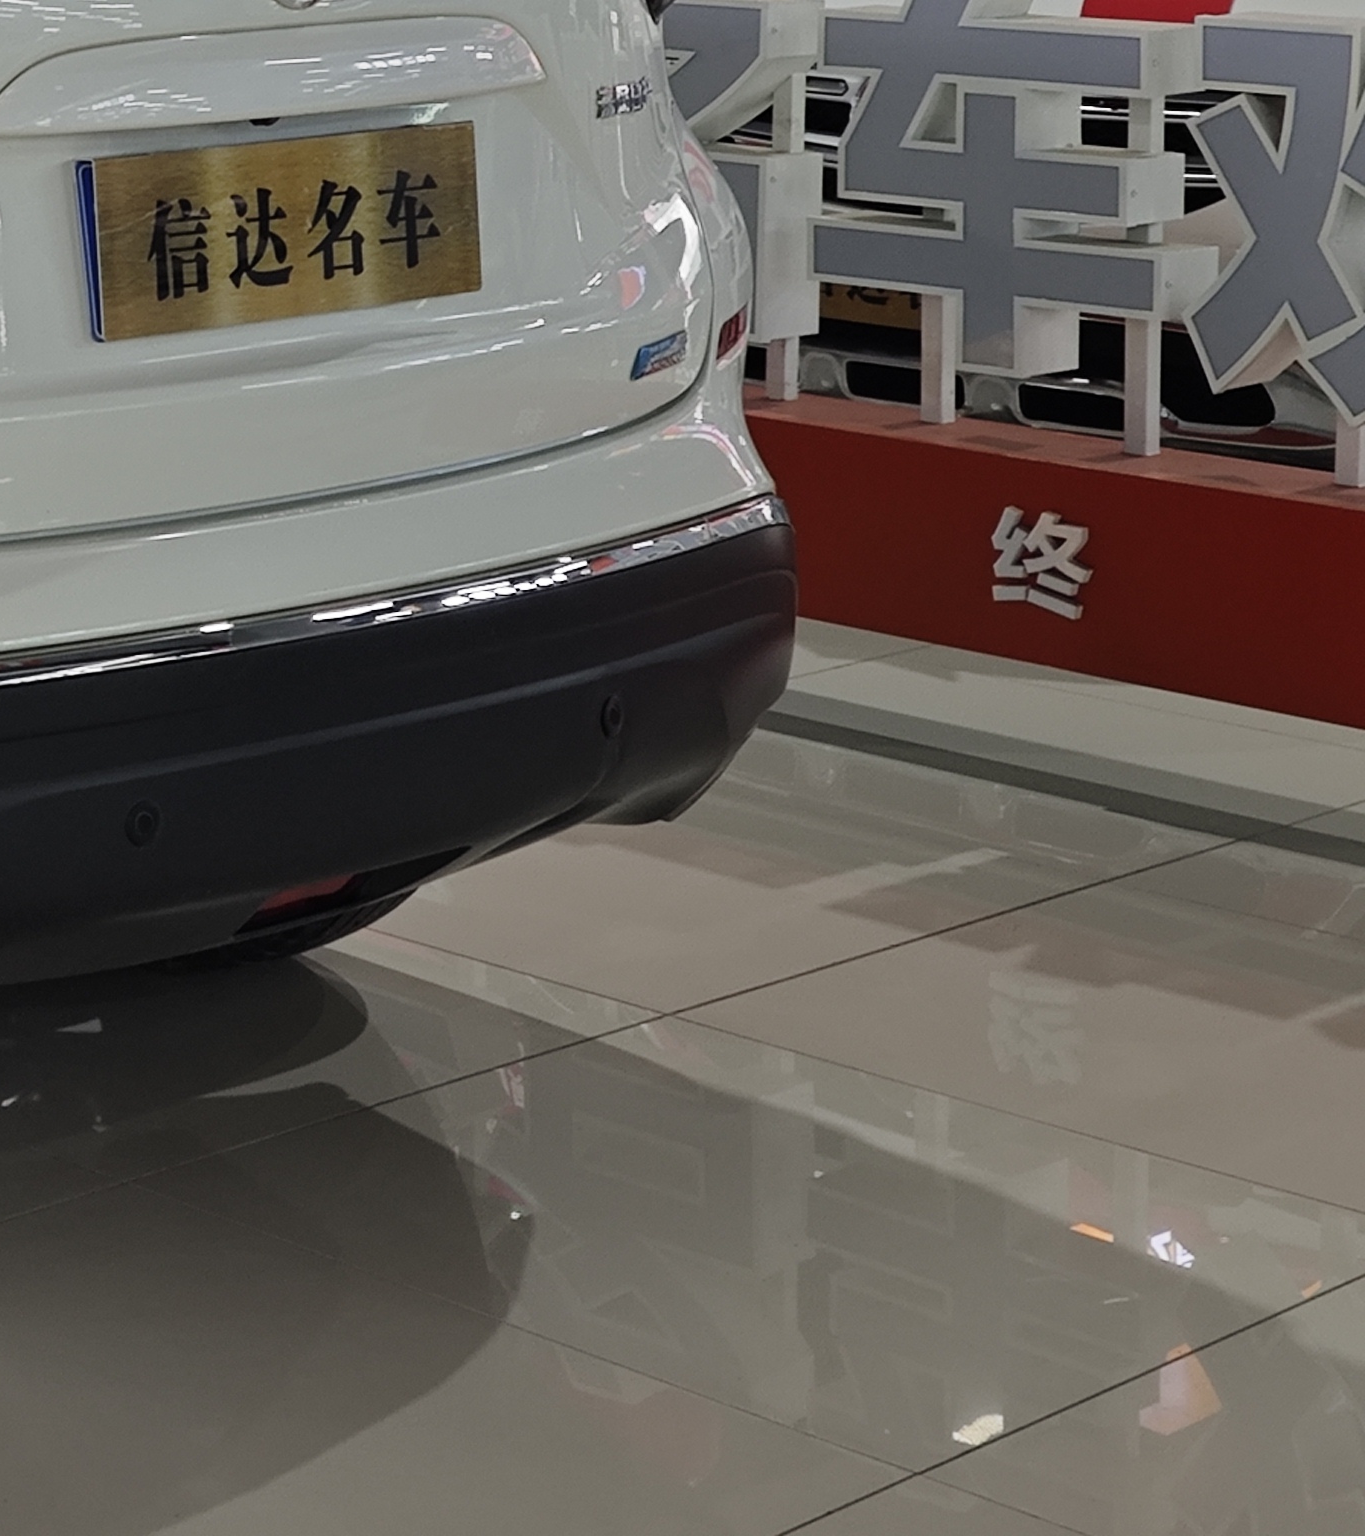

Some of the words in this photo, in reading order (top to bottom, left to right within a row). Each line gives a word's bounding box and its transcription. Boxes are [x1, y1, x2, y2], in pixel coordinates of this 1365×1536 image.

[146, 169, 442, 302] 信达名车
[989, 504, 1095, 621] 终
